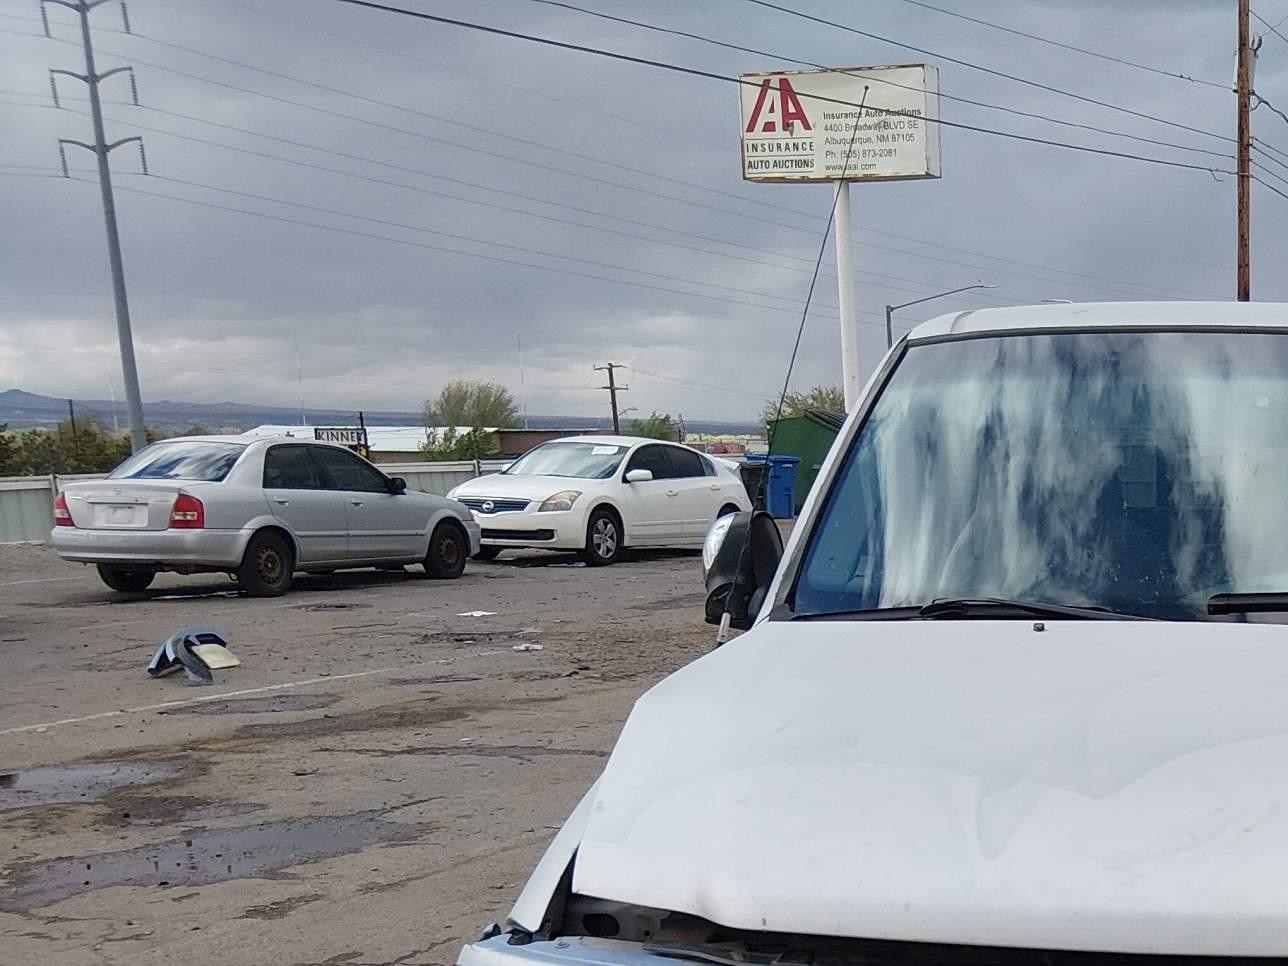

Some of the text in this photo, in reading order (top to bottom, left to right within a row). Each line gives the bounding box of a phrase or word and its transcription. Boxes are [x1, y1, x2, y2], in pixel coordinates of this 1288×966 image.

[823, 123, 843, 132] 4400
[883, 120, 905, 130] BLVD
[907, 121, 919, 129] SE
[876, 135, 890, 143] NM
[746, 141, 815, 153] INSURANCE
[861, 148, 897, 158] 873-2081
[747, 158, 815, 170] AUTO AUCTIONS
[824, 162, 877, 171] www.aai.com
